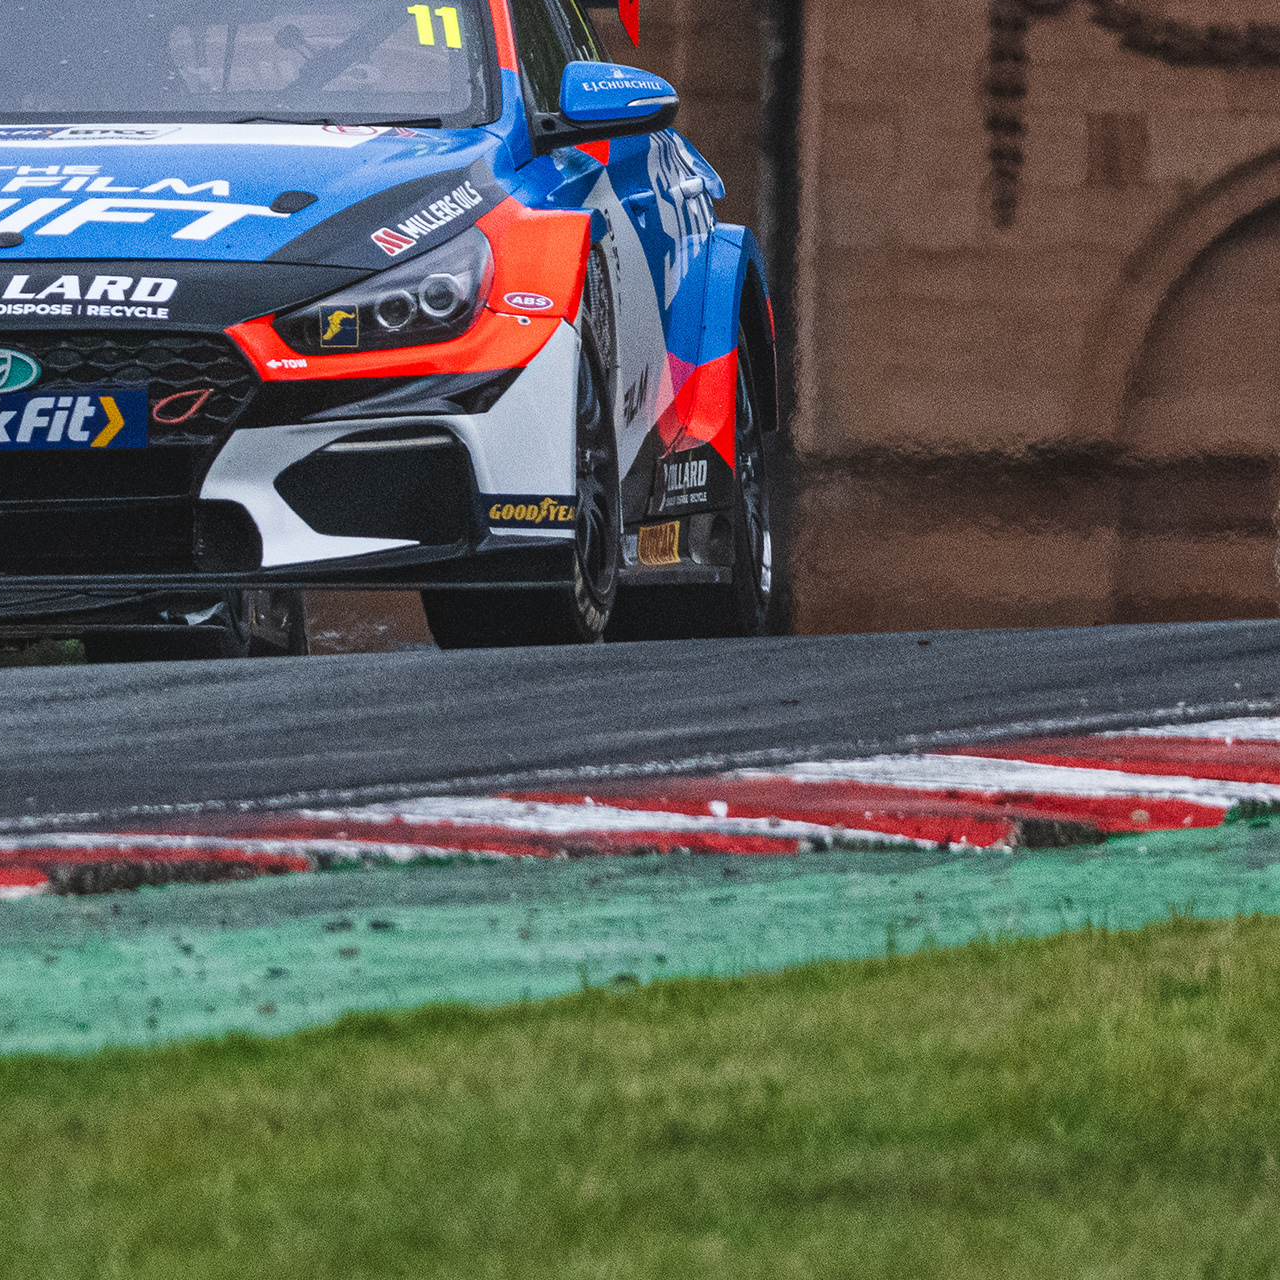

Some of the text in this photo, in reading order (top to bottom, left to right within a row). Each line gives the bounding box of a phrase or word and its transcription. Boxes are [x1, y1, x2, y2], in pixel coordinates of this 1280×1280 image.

[407, 4, 462, 49] 11
[7, 176, 231, 197] FILM
[397, 180, 483, 239] MILLERS OILS
[86, 304, 169, 319] RECYCLE
[512, 296, 547, 306] ABS
[281, 359, 308, 369] TOW
[489, 497, 575, 523] GOODYEA
